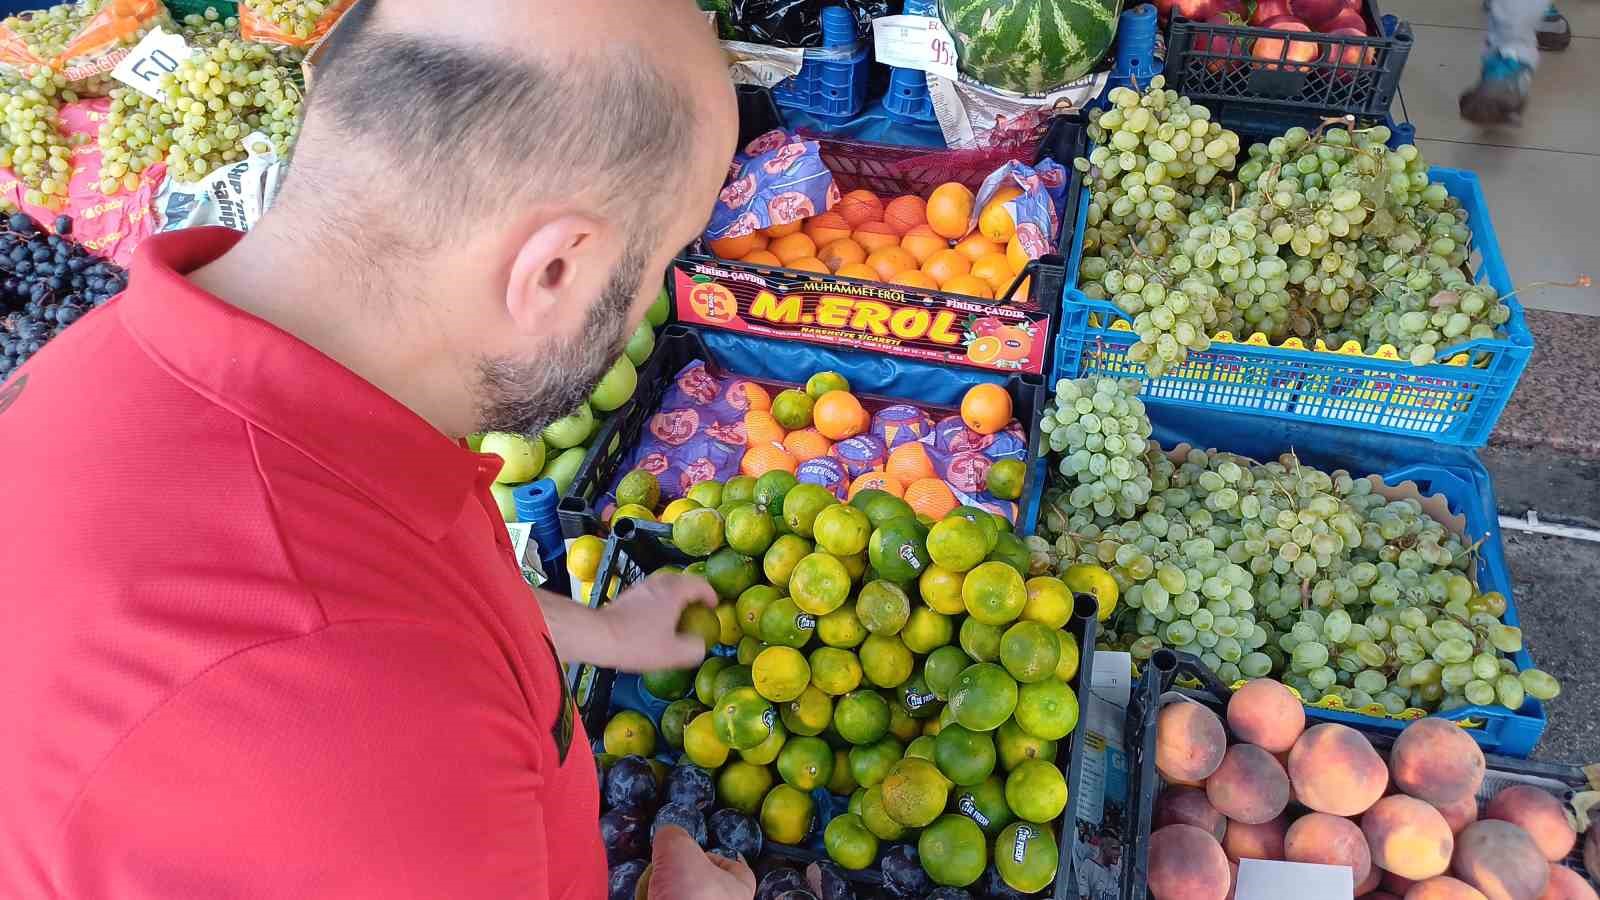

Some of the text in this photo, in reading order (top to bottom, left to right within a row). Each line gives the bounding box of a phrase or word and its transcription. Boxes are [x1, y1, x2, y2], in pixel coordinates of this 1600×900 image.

[803, 282, 907, 302] MUHAMMET EROL
[750, 289, 962, 344] M.EROL
